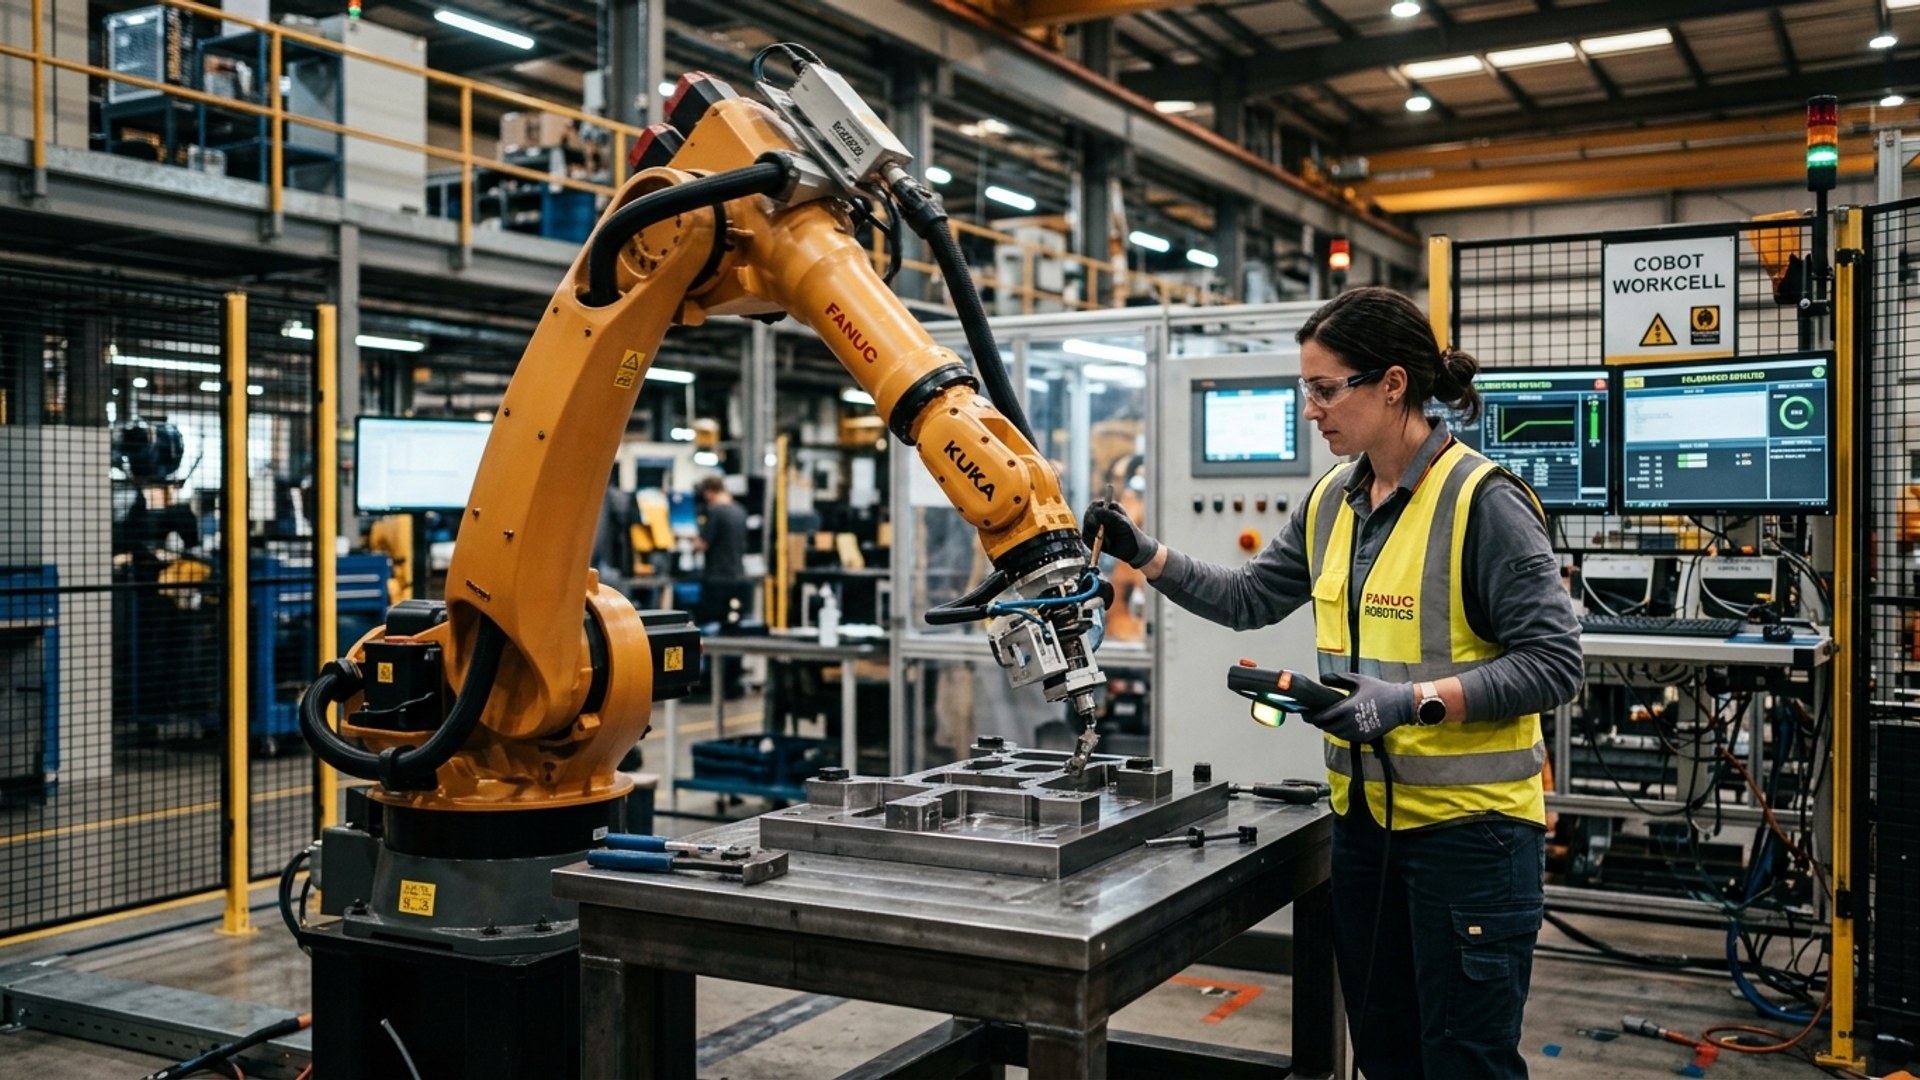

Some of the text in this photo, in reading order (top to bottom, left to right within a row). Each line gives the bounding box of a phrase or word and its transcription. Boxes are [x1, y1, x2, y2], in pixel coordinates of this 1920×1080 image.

[1634, 253, 1704, 272] COBOT
[1613, 273, 1725, 294] WORKCELL
[825, 302, 878, 364] FANUC
[943, 439, 995, 502] KUKA
[1364, 605, 1414, 620] ROBOTICS
